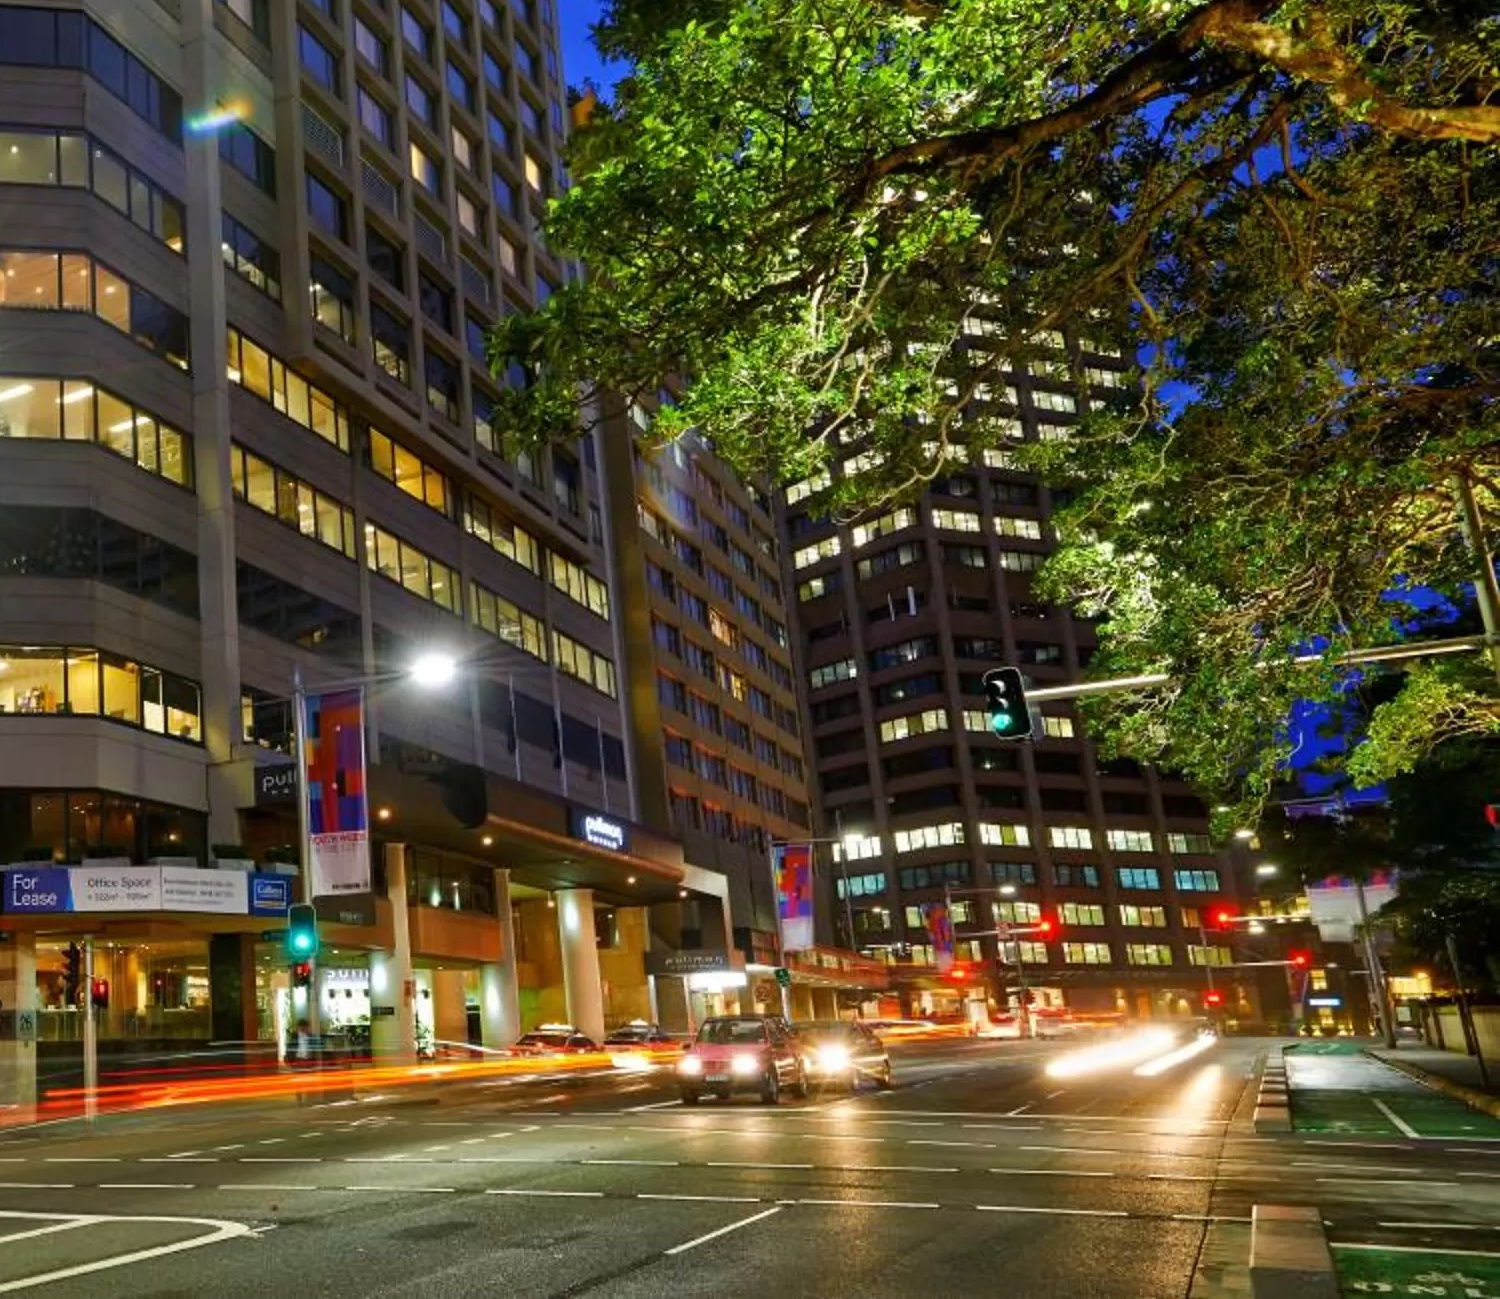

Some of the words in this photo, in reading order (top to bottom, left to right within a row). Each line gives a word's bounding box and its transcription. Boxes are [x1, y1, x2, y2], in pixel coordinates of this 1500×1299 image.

[263, 770, 298, 793] pull
[12, 874, 38, 889] For
[87, 877, 118, 888] Office
[121, 877, 152, 890] Space
[12, 889, 57, 906] Lease
